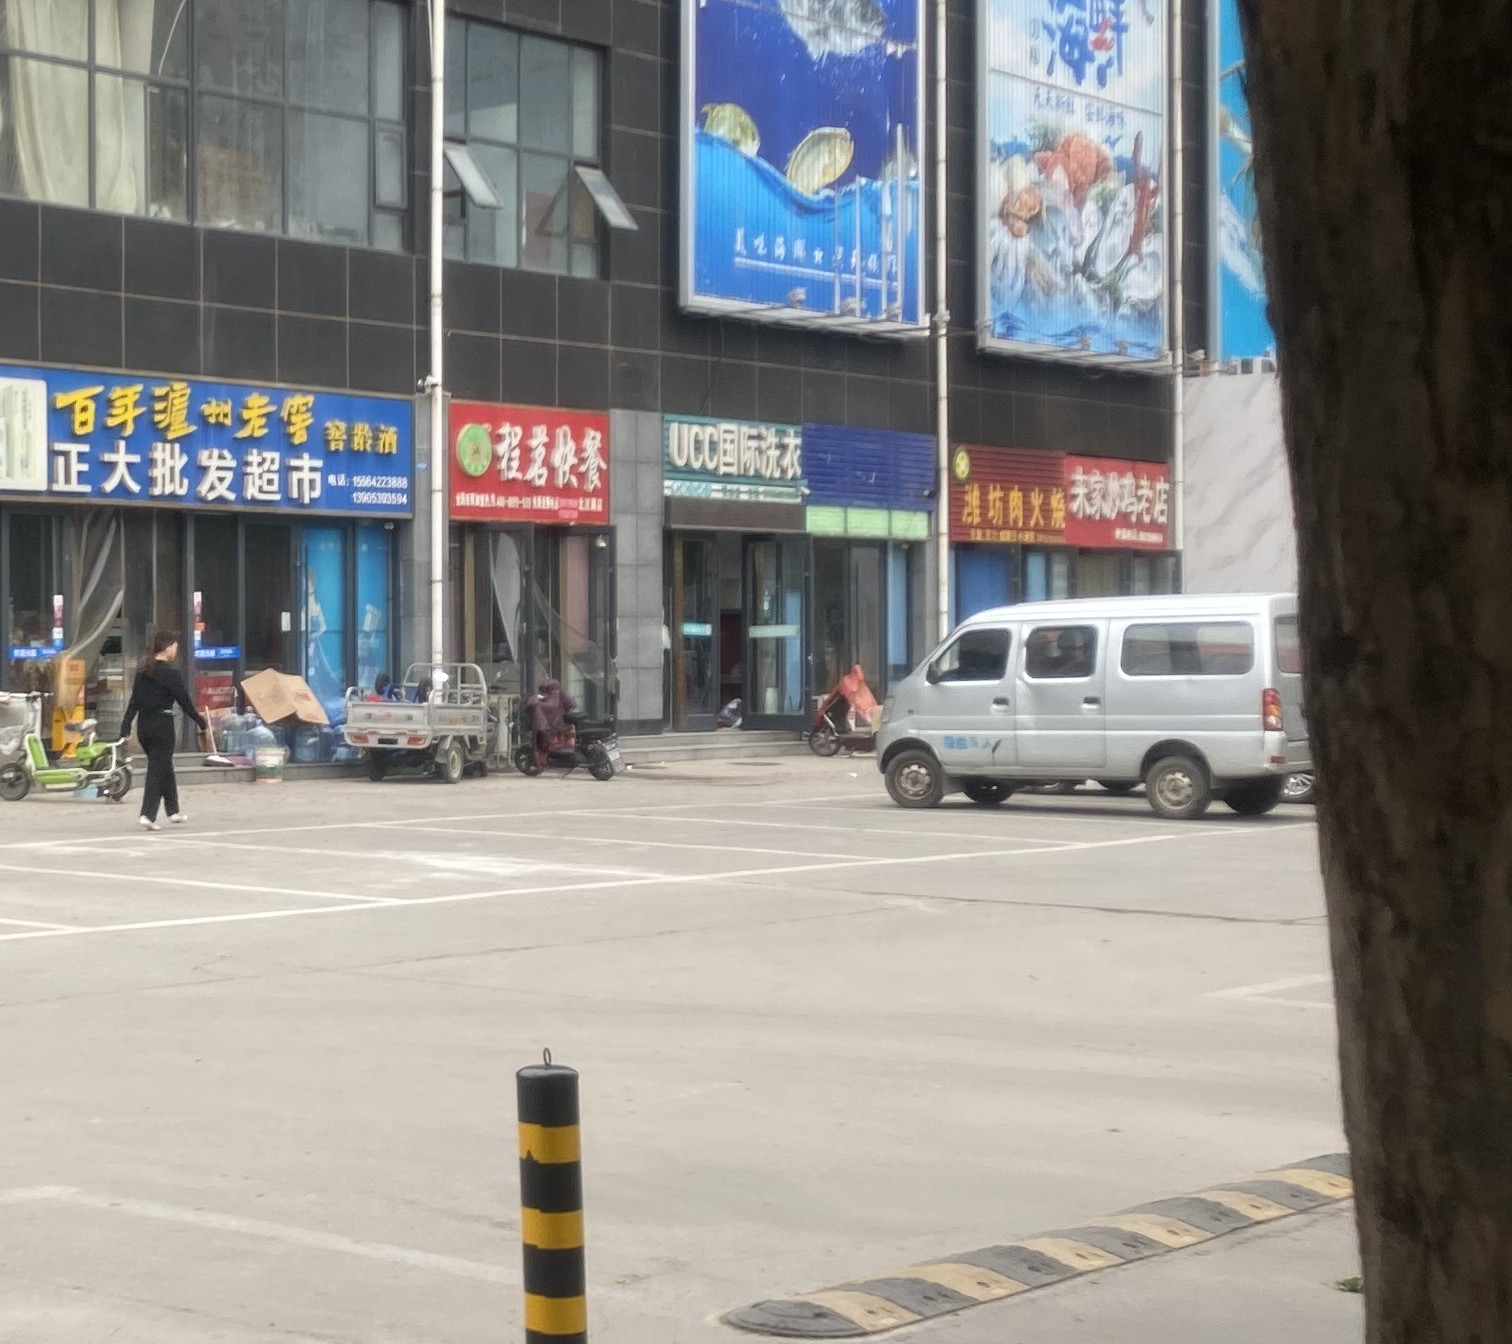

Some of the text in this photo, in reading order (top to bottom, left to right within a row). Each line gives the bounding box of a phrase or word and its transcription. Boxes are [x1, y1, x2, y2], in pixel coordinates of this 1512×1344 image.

[54, 381, 316, 446] 百年泸州老窖
[51, 439, 325, 505] 正大批发超市
[669, 421, 802, 481] UCC国际洗衣
[962, 482, 1066, 529] 潍坊肉火烧
